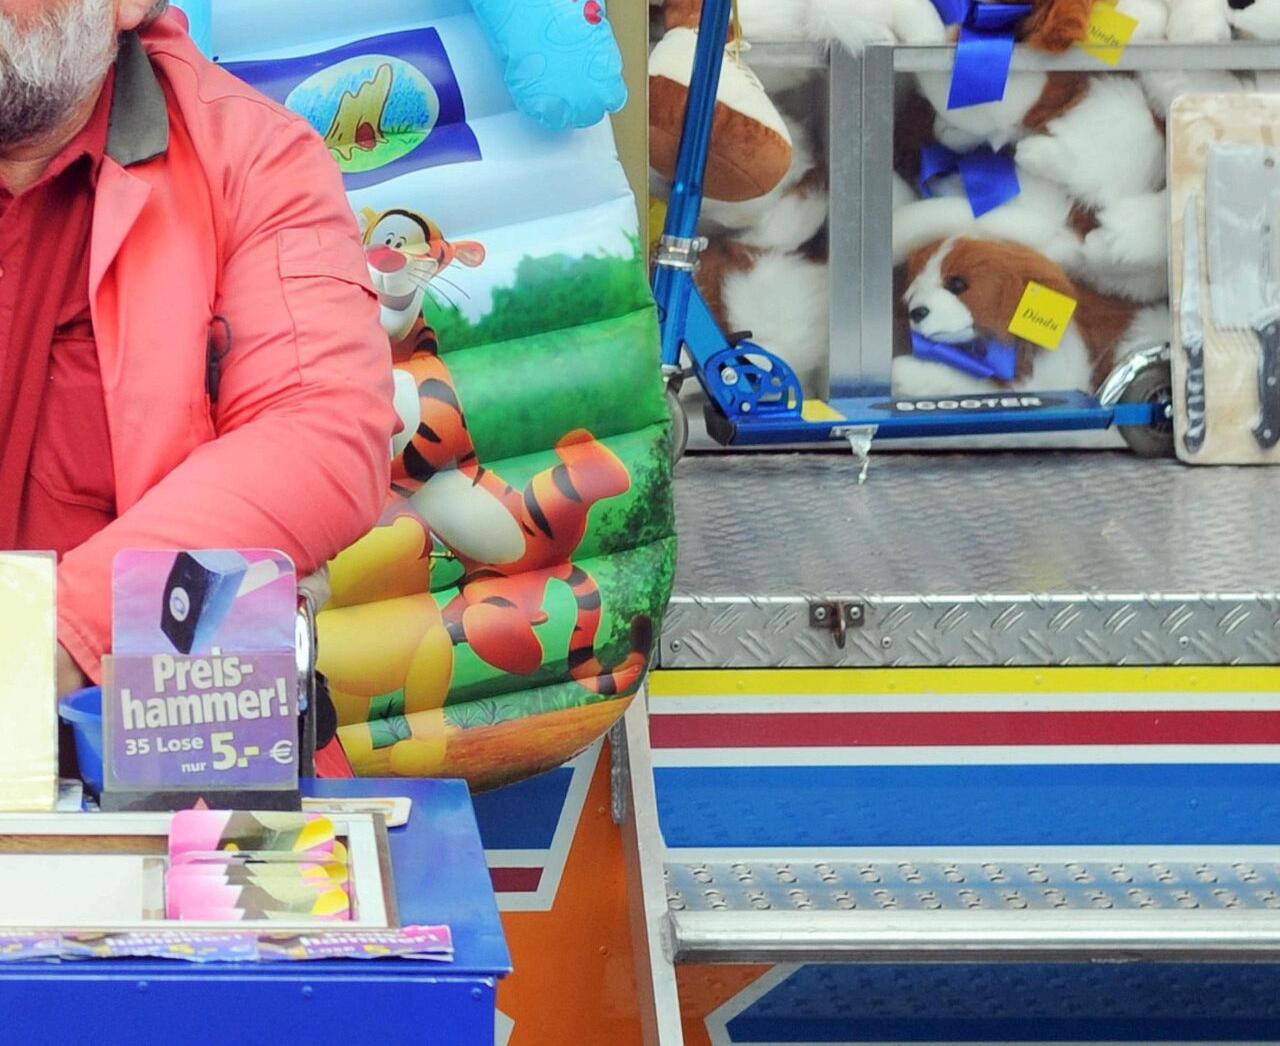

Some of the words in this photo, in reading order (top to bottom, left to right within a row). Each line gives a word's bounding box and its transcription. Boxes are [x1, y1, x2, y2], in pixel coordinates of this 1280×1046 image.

[895, 397, 1043, 412] SCOOTER
[152, 646, 254, 693] Preis-
[120, 677, 289, 731] hammer!
[125, 738, 151, 756] 35
[156, 736, 205, 753] Lose
[180, 760, 208, 774] nur
[269, 739, 294, 765] €
